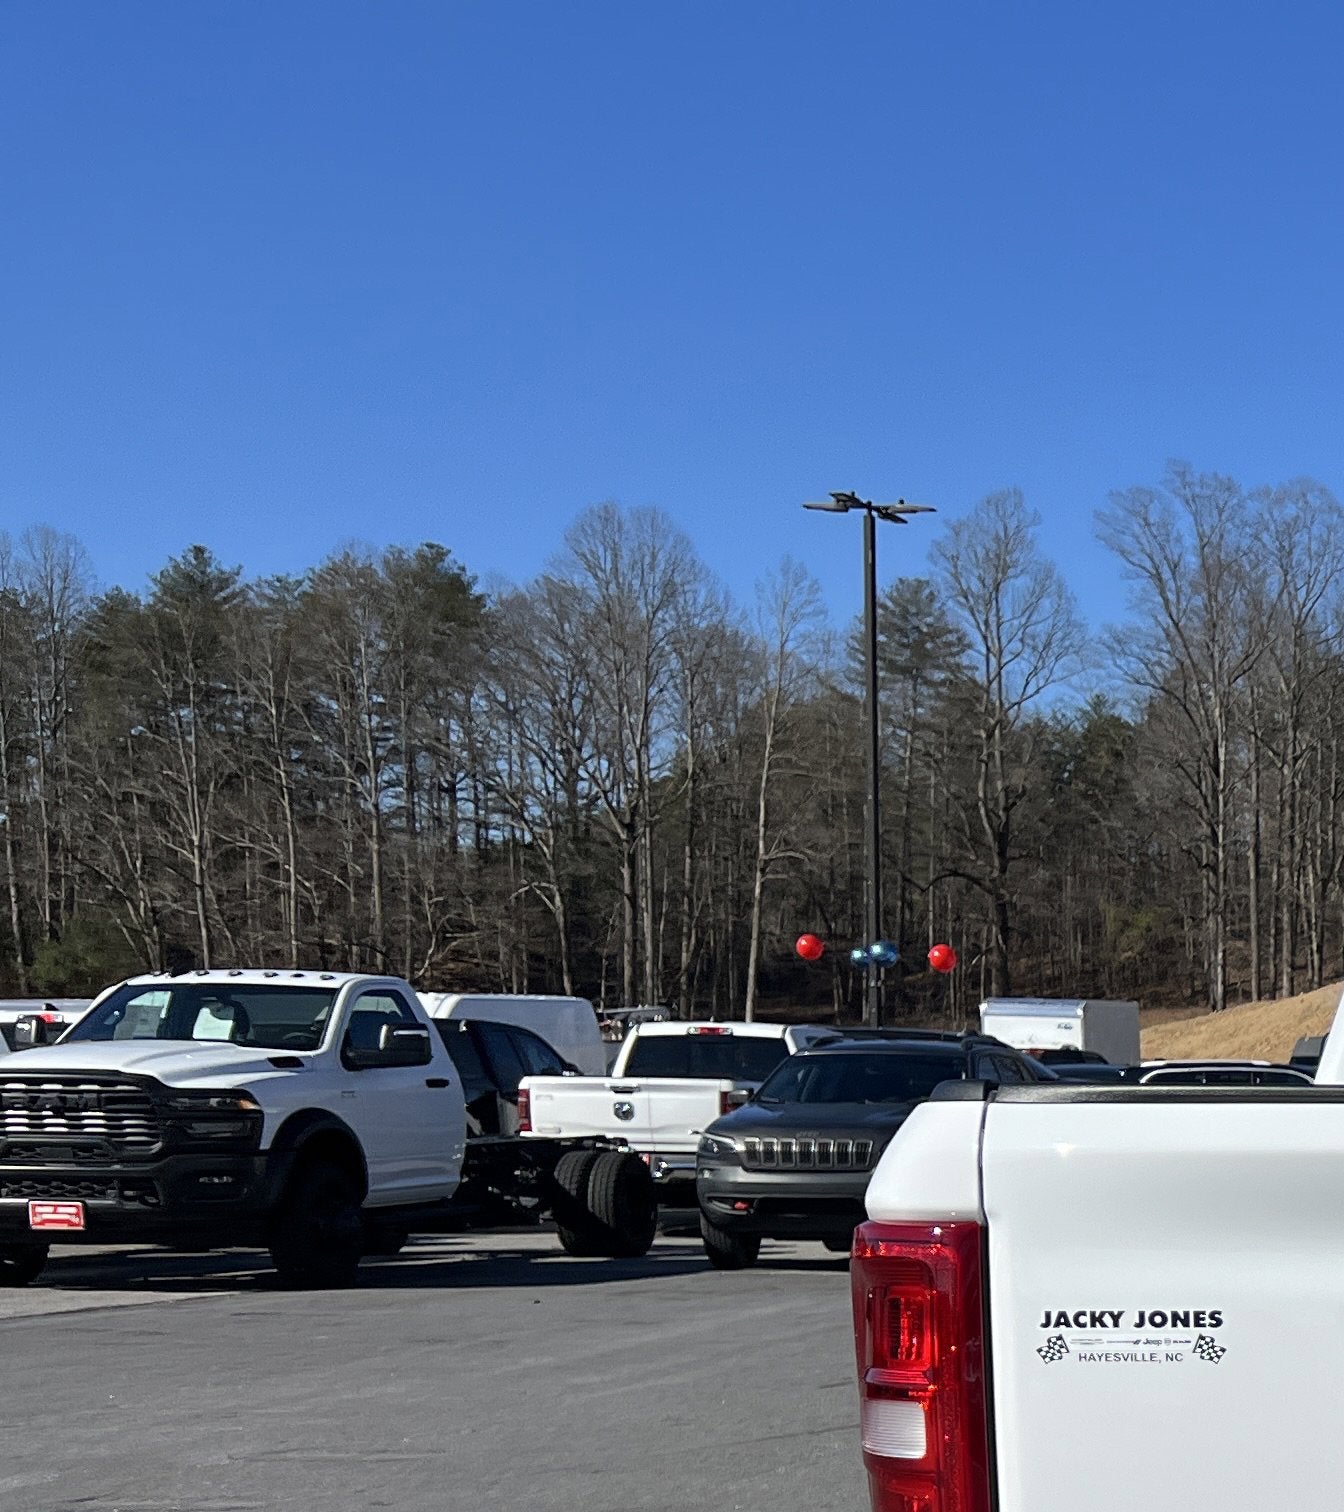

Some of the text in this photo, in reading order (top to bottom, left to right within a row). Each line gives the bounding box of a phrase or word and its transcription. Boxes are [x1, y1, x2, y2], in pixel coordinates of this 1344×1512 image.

[1039, 1309, 1224, 1329] JACKY JONES
[1078, 1352, 1184, 1364] HAYESVILLE, NC
